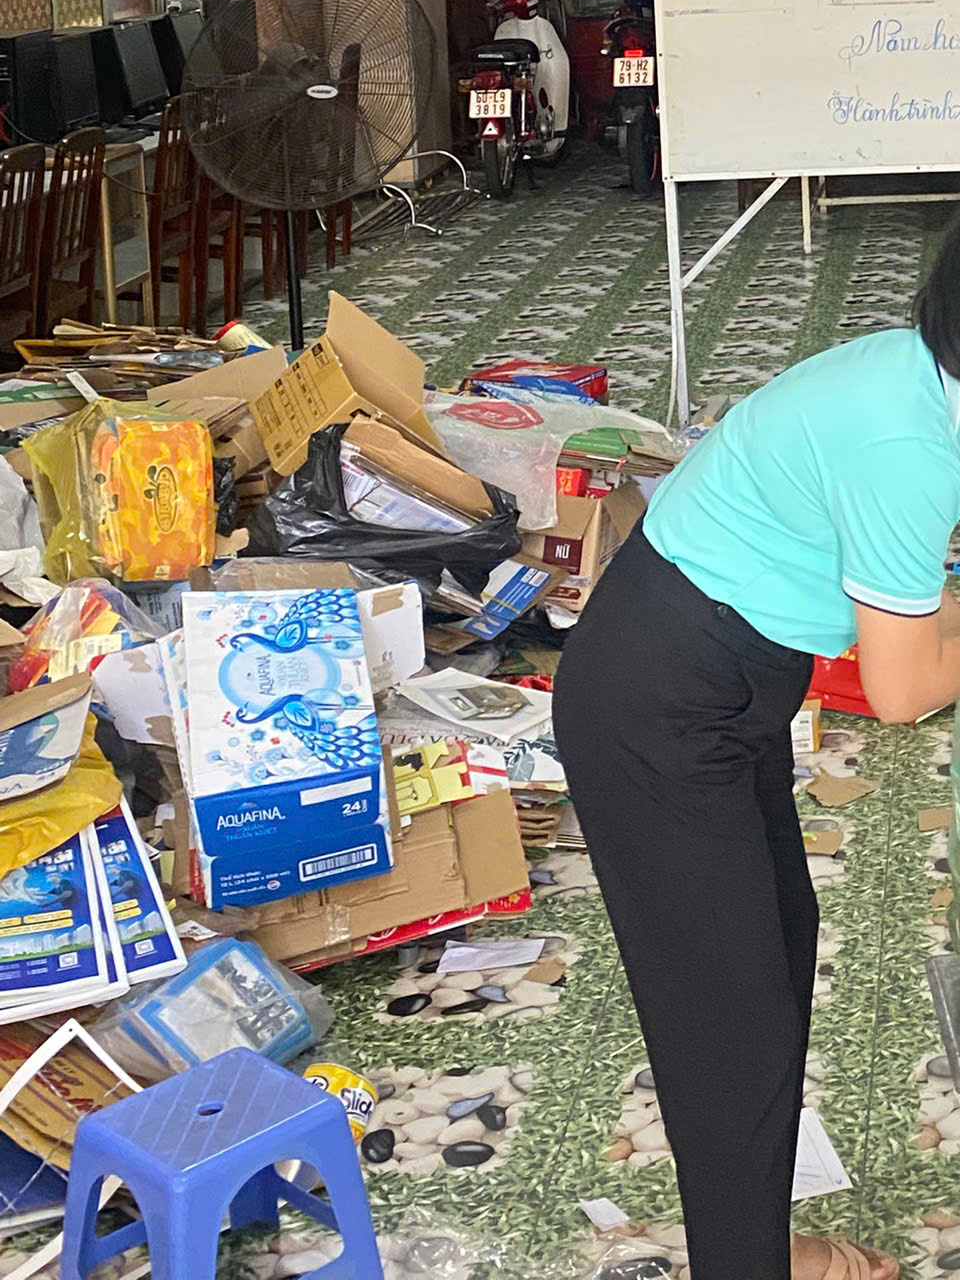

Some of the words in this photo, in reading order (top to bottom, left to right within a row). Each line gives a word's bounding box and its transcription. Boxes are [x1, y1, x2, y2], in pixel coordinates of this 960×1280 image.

[850, 18, 919, 57] Năm
[619, 59, 649, 71] 79-H2
[618, 72, 649, 84] 6132
[476, 105, 506, 117] 3819
[903, 90, 953, 120] trình
[555, 543, 571, 559] NỮ
[255, 653, 277, 697] AQUAFINA
[342, 801, 361, 814] 24
[216, 806, 283, 831] AQUAFINA
[340, 1086, 374, 1117] Slid
